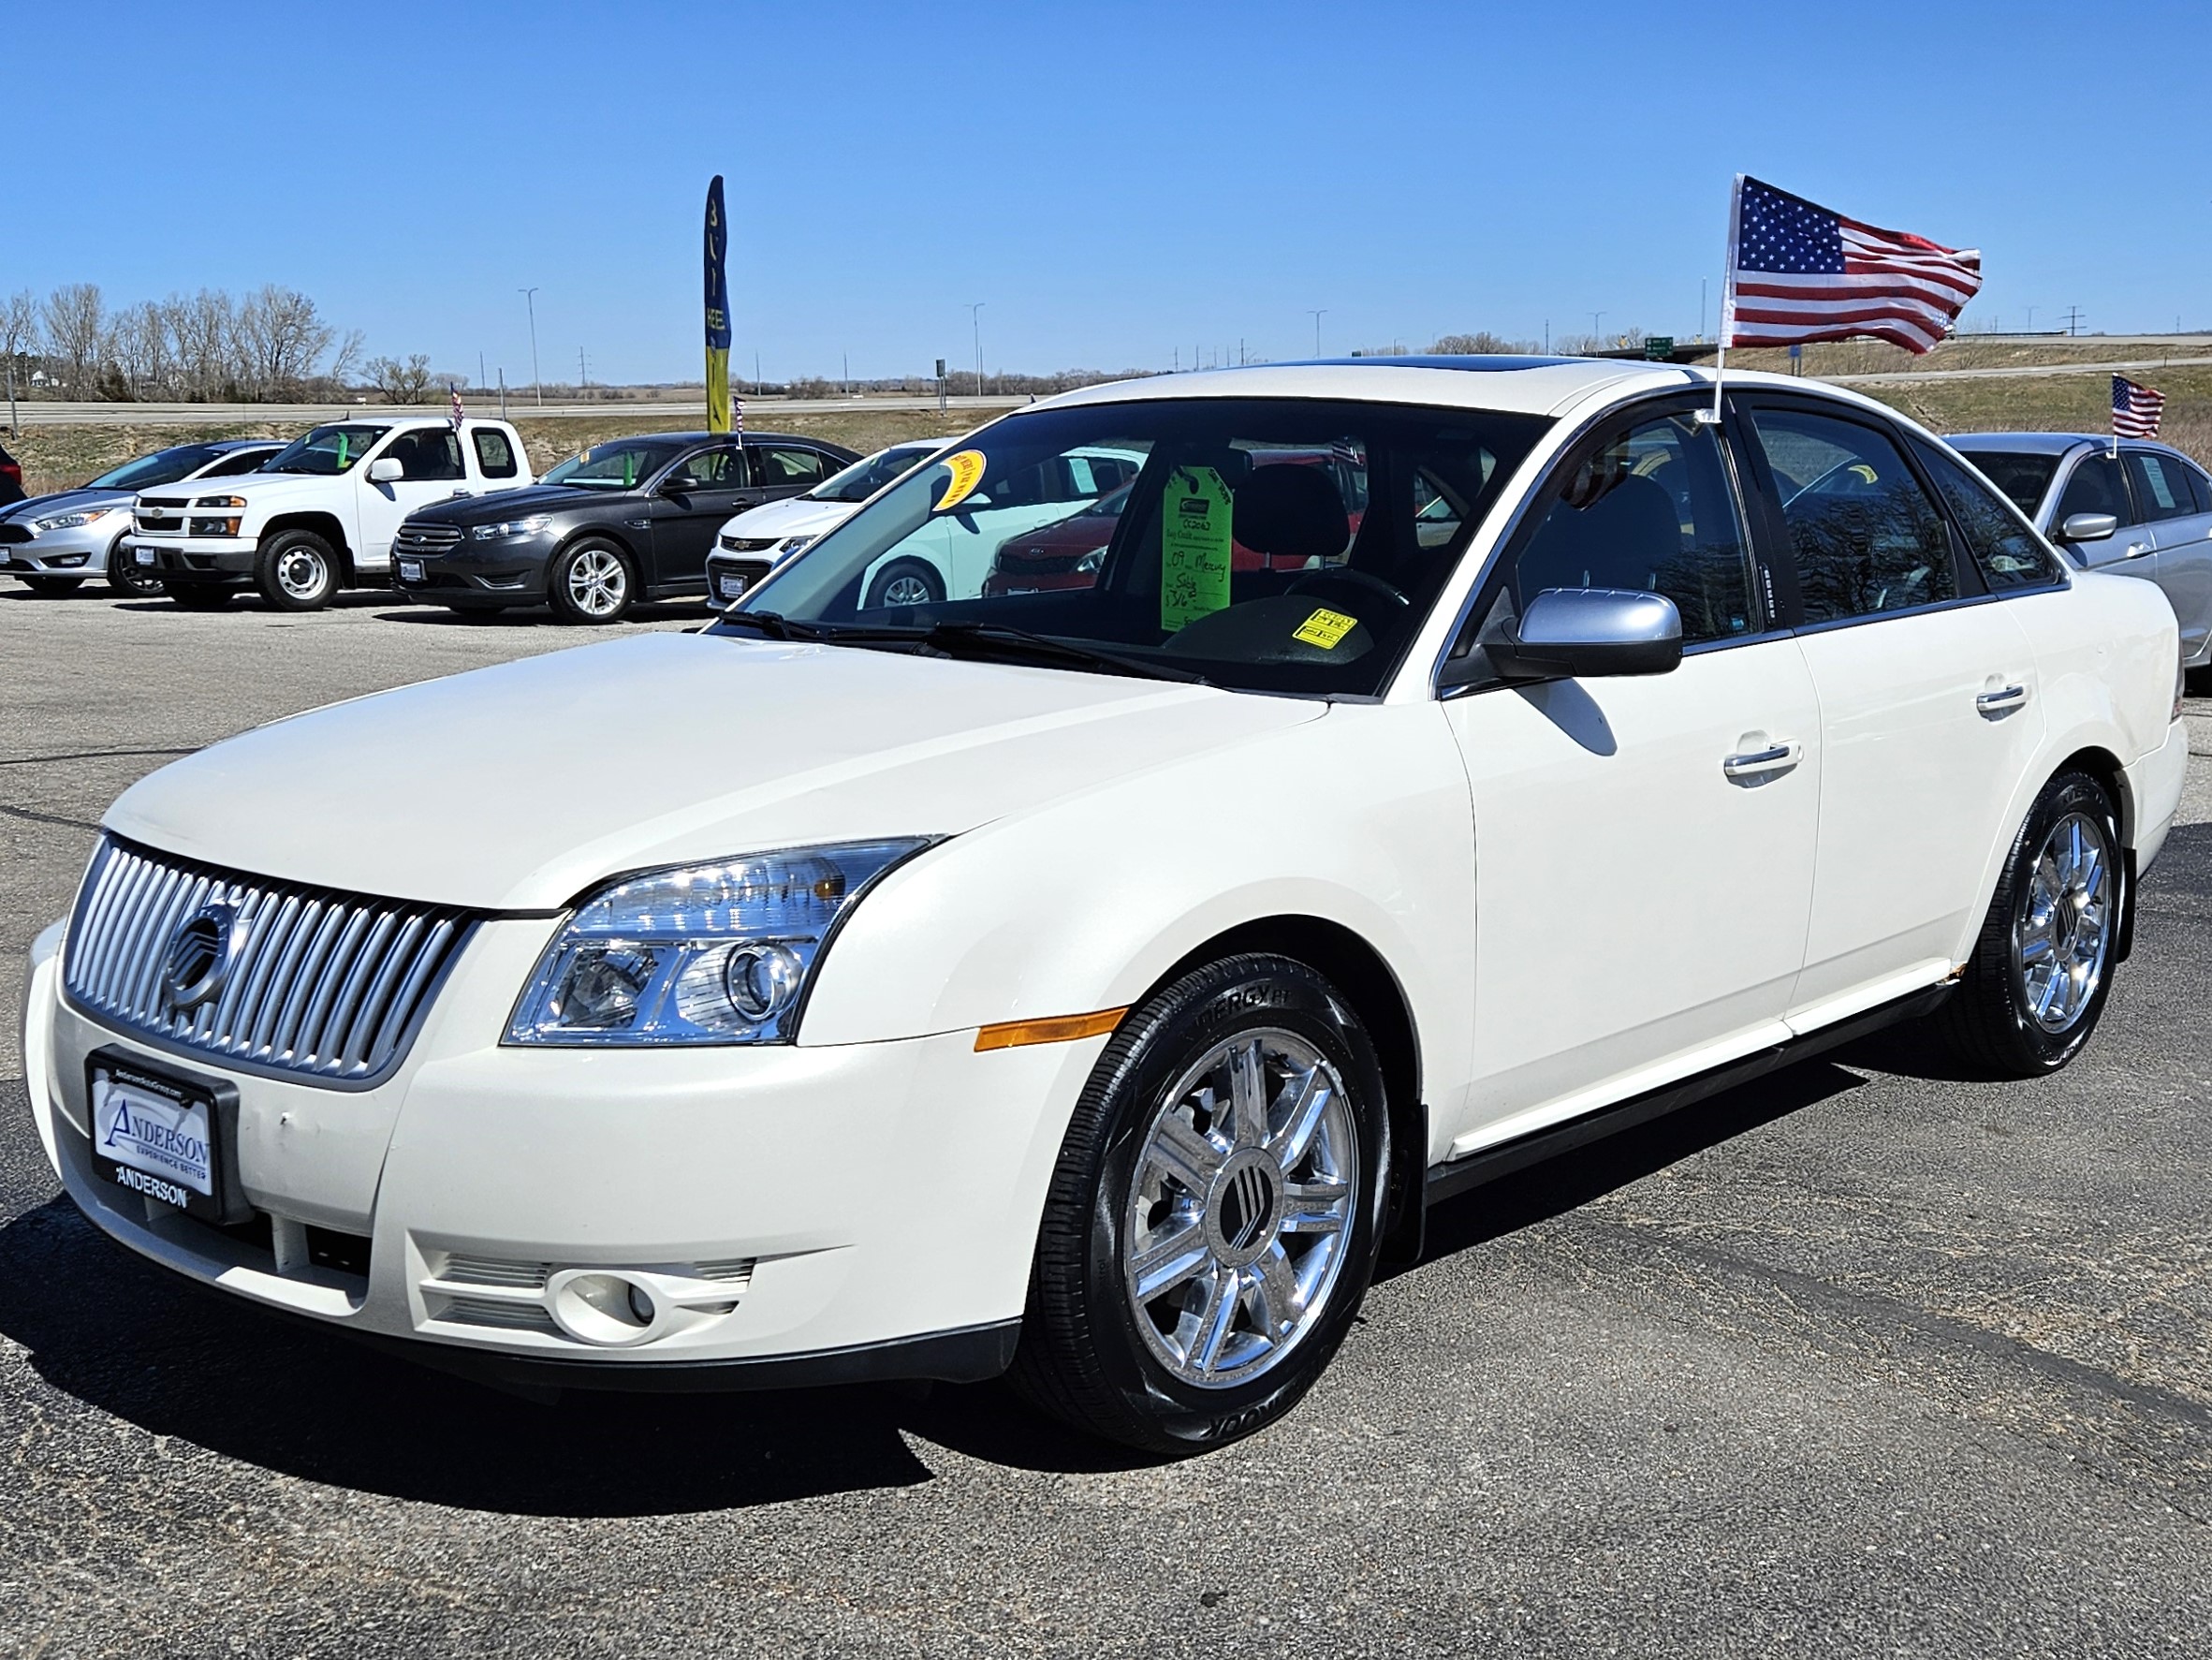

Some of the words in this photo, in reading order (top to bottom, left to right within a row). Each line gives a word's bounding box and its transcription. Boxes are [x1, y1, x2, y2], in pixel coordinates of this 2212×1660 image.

[1171, 551, 1185, 566] 09
[104, 1098, 208, 1165] ANDERSON
[136, 1145, 179, 1170] EXPERIENCE
[180, 1163, 207, 1181] BETTER
[116, 1167, 187, 1209] ANDERSON
